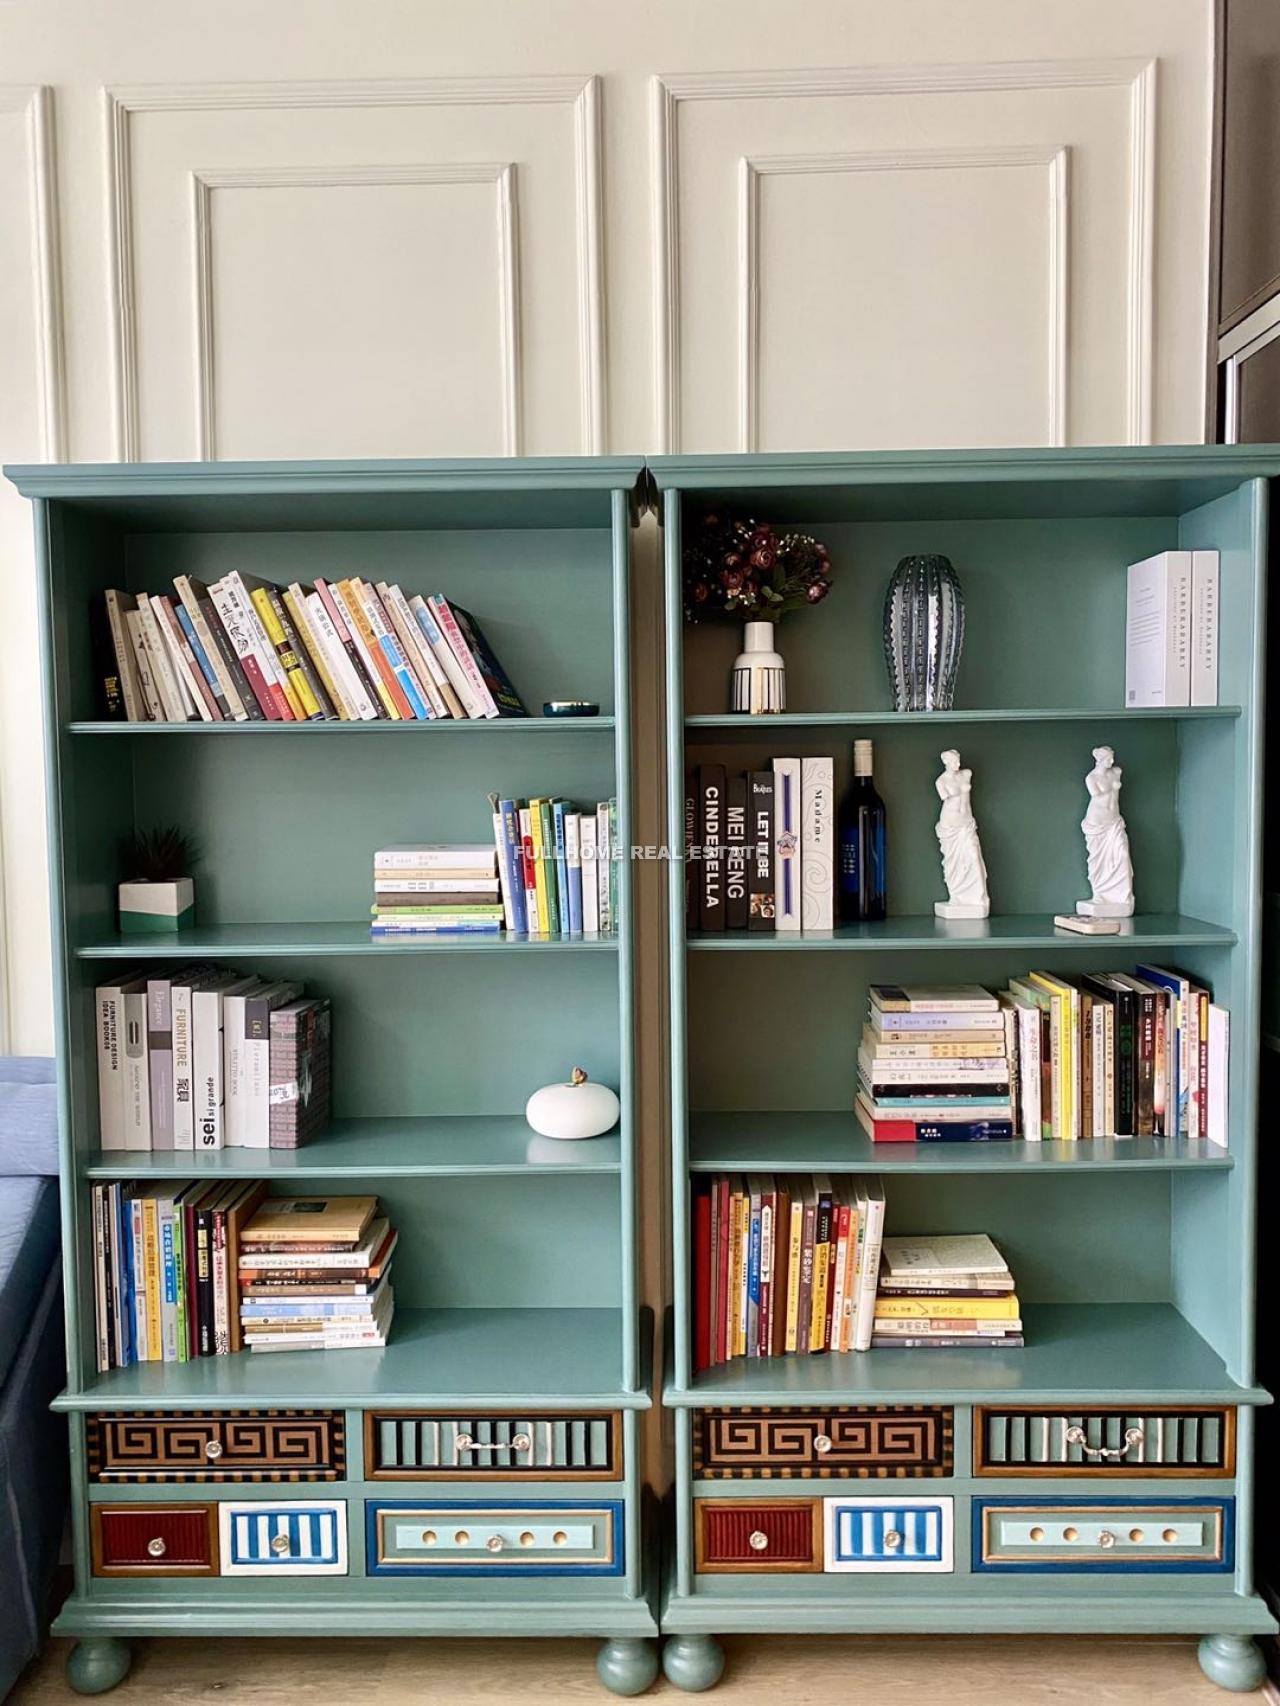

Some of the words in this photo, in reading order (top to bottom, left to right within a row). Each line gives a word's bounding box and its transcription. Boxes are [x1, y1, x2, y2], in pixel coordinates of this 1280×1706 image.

[727, 807, 744, 840] MEI
[757, 811, 769, 839] LET
[814, 789, 822, 843] Madame
[706, 786, 719, 908] CINDERELLA
[757, 858, 769, 878] BE
[109, 1000, 117, 1042] FURNITURE
[176, 1008, 187, 1067] FURNITURE
[110, 1043, 119, 1071] DESIGN
[206, 1077, 216, 1107] grande
[199, 1118, 215, 1145] sei
